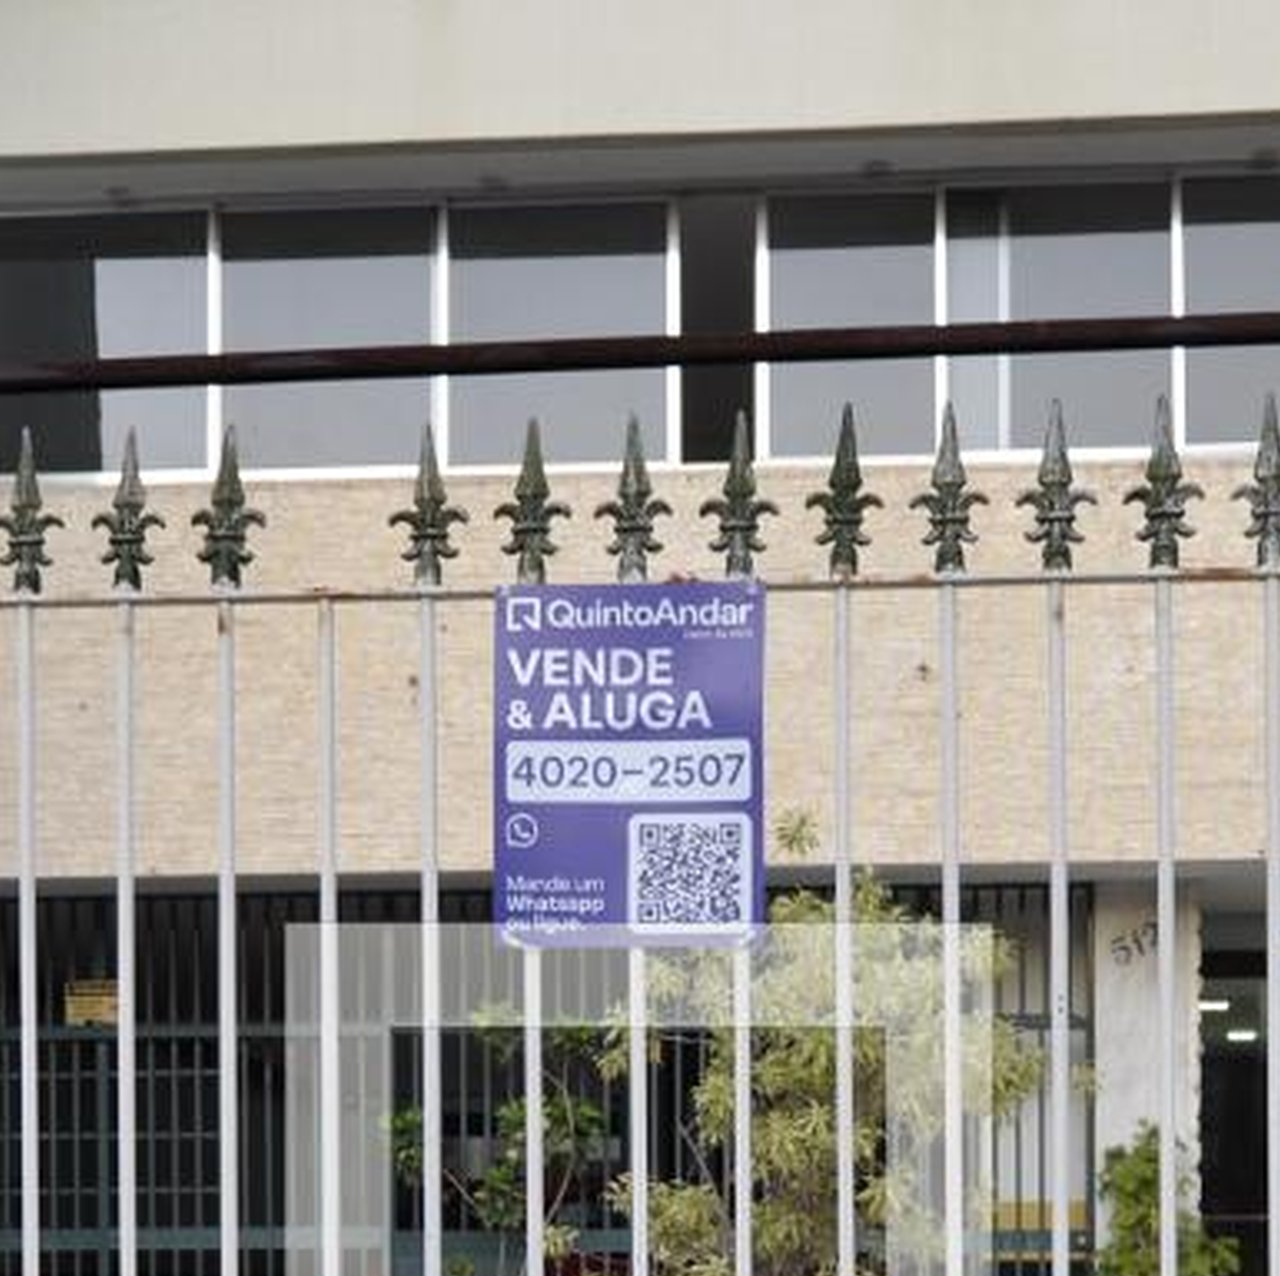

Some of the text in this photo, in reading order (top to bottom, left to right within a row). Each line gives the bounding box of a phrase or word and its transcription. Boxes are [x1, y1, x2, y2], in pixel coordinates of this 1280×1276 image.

[547, 599, 754, 629] QuintoAndar
[506, 648, 673, 686] VENDE
[507, 690, 712, 730] & ALUGA
[511, 755, 746, 788] 4020-2507
